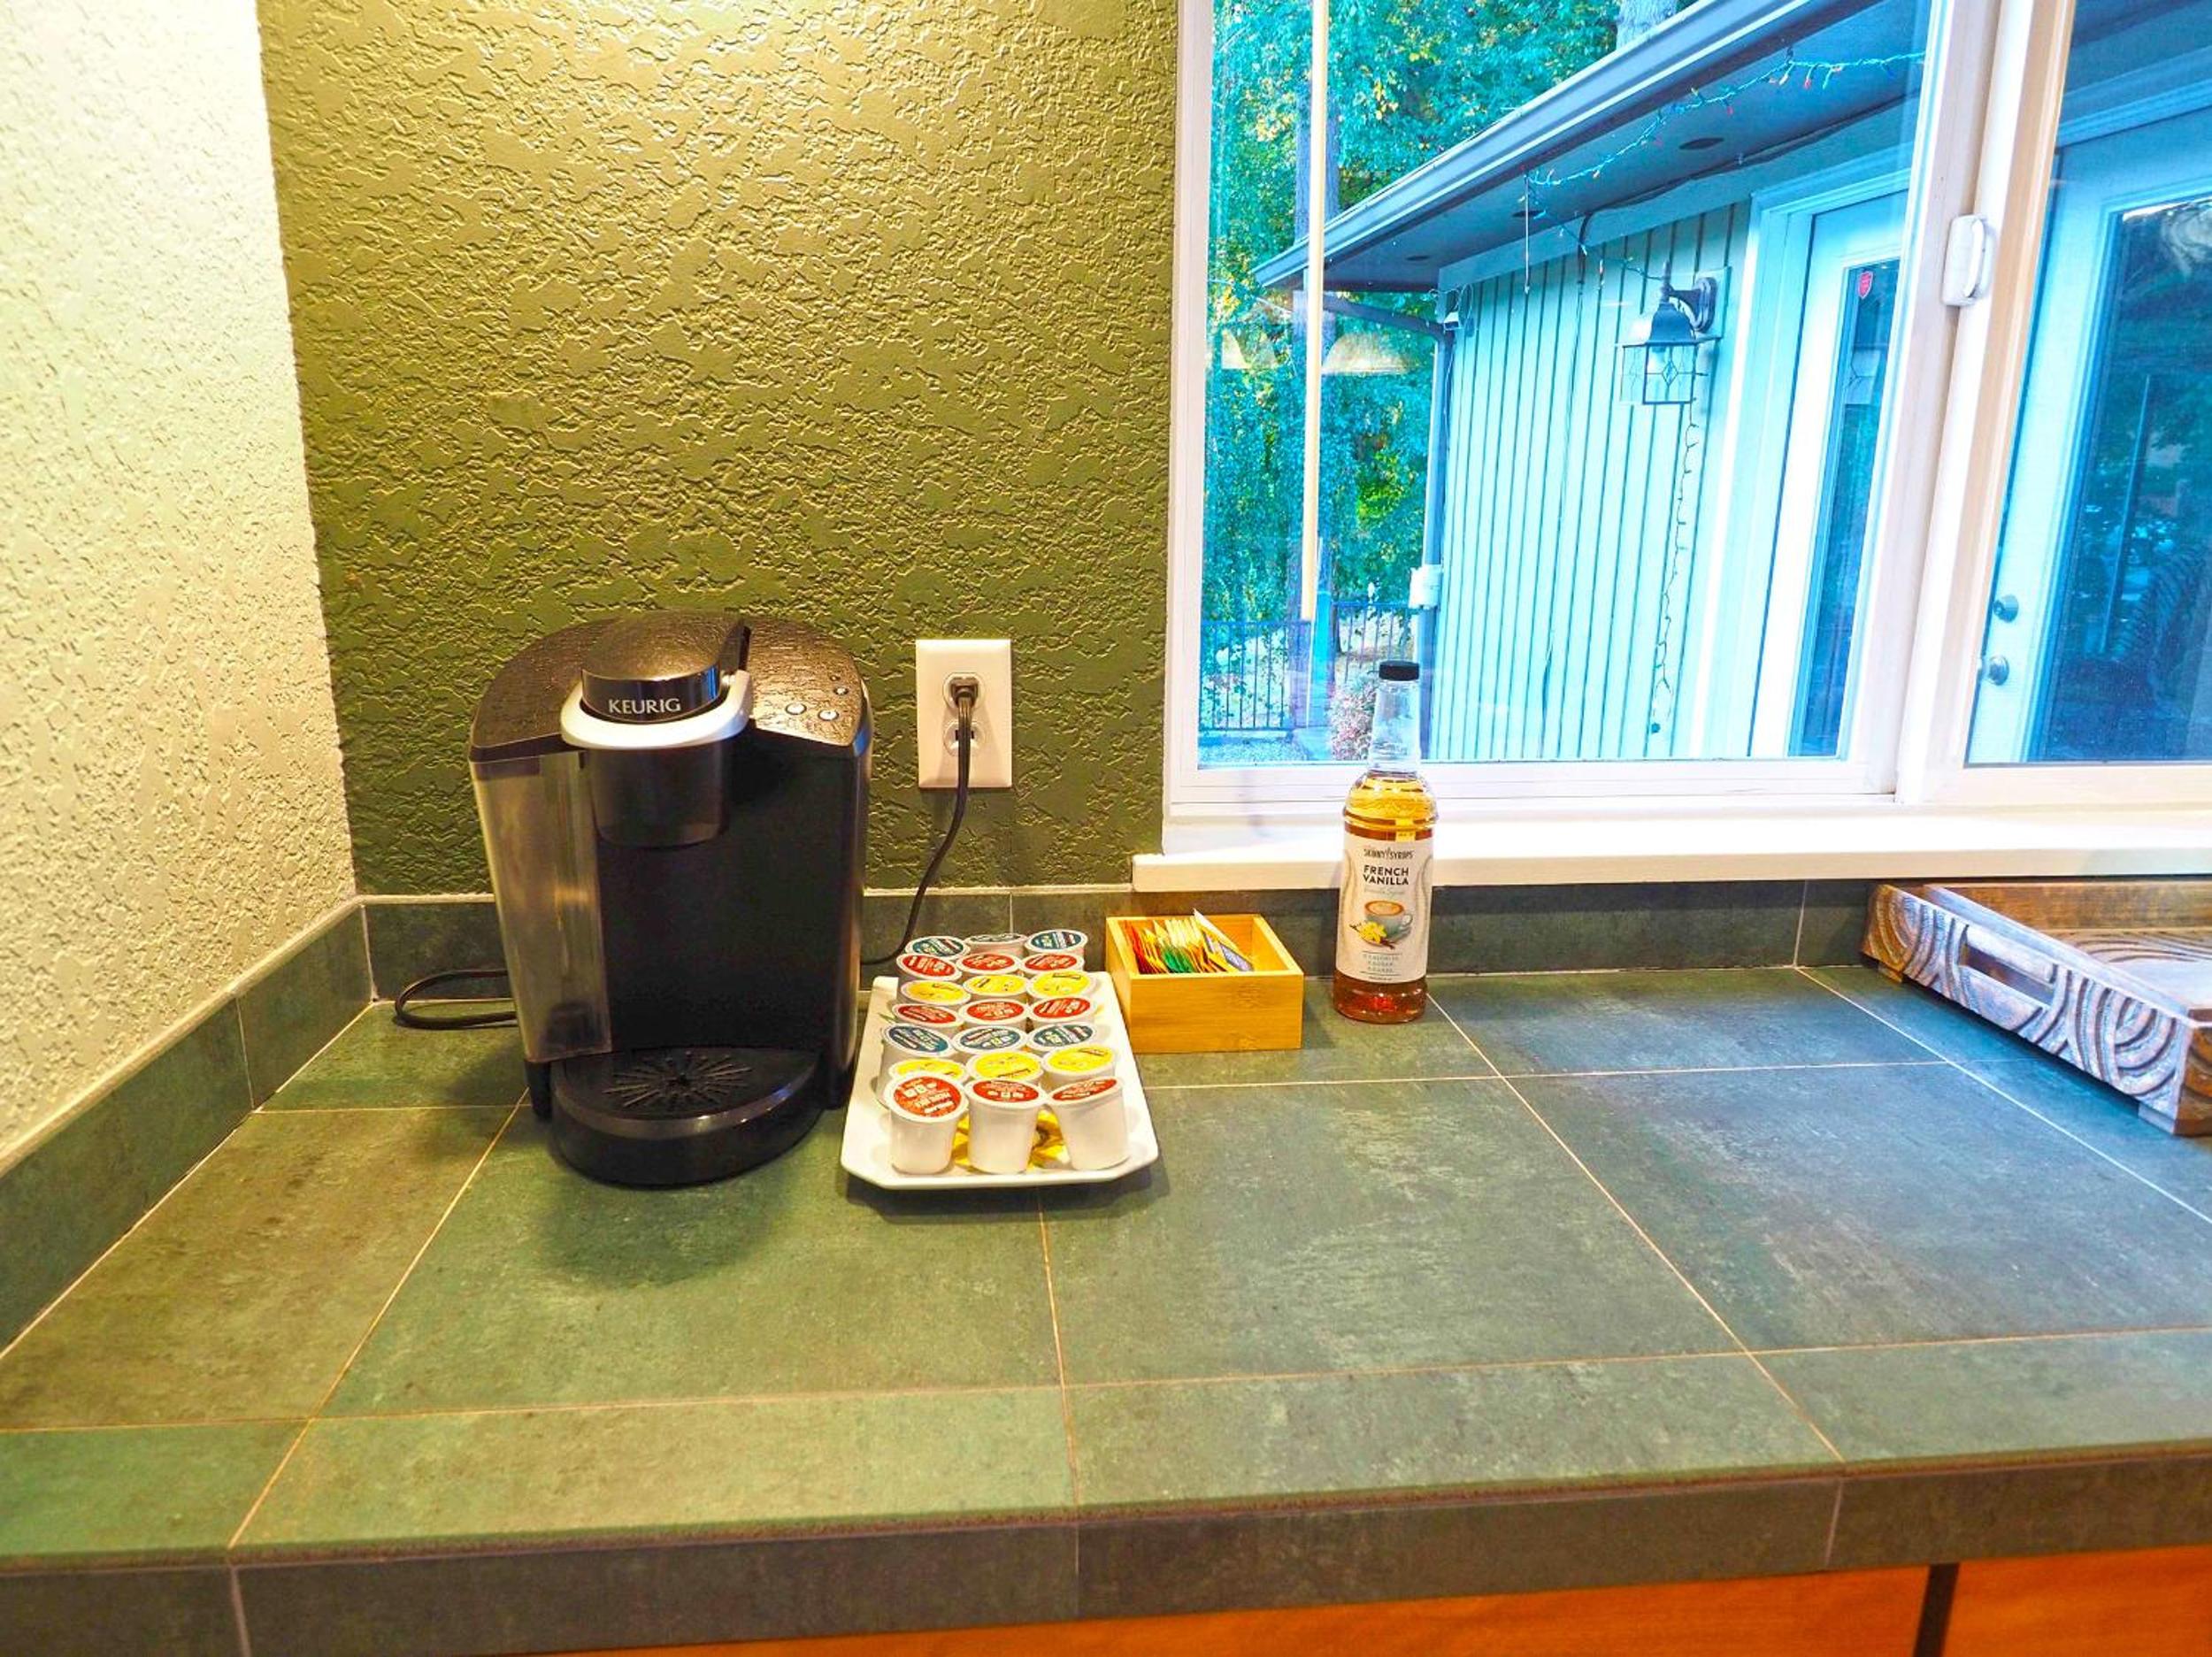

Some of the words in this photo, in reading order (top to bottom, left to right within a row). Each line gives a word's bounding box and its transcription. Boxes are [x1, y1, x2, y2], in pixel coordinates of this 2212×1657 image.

[608, 697, 681, 715] KEURIG
[1363, 864, 1409, 876] FRENCH
[1363, 874, 1409, 886] VANILLA
